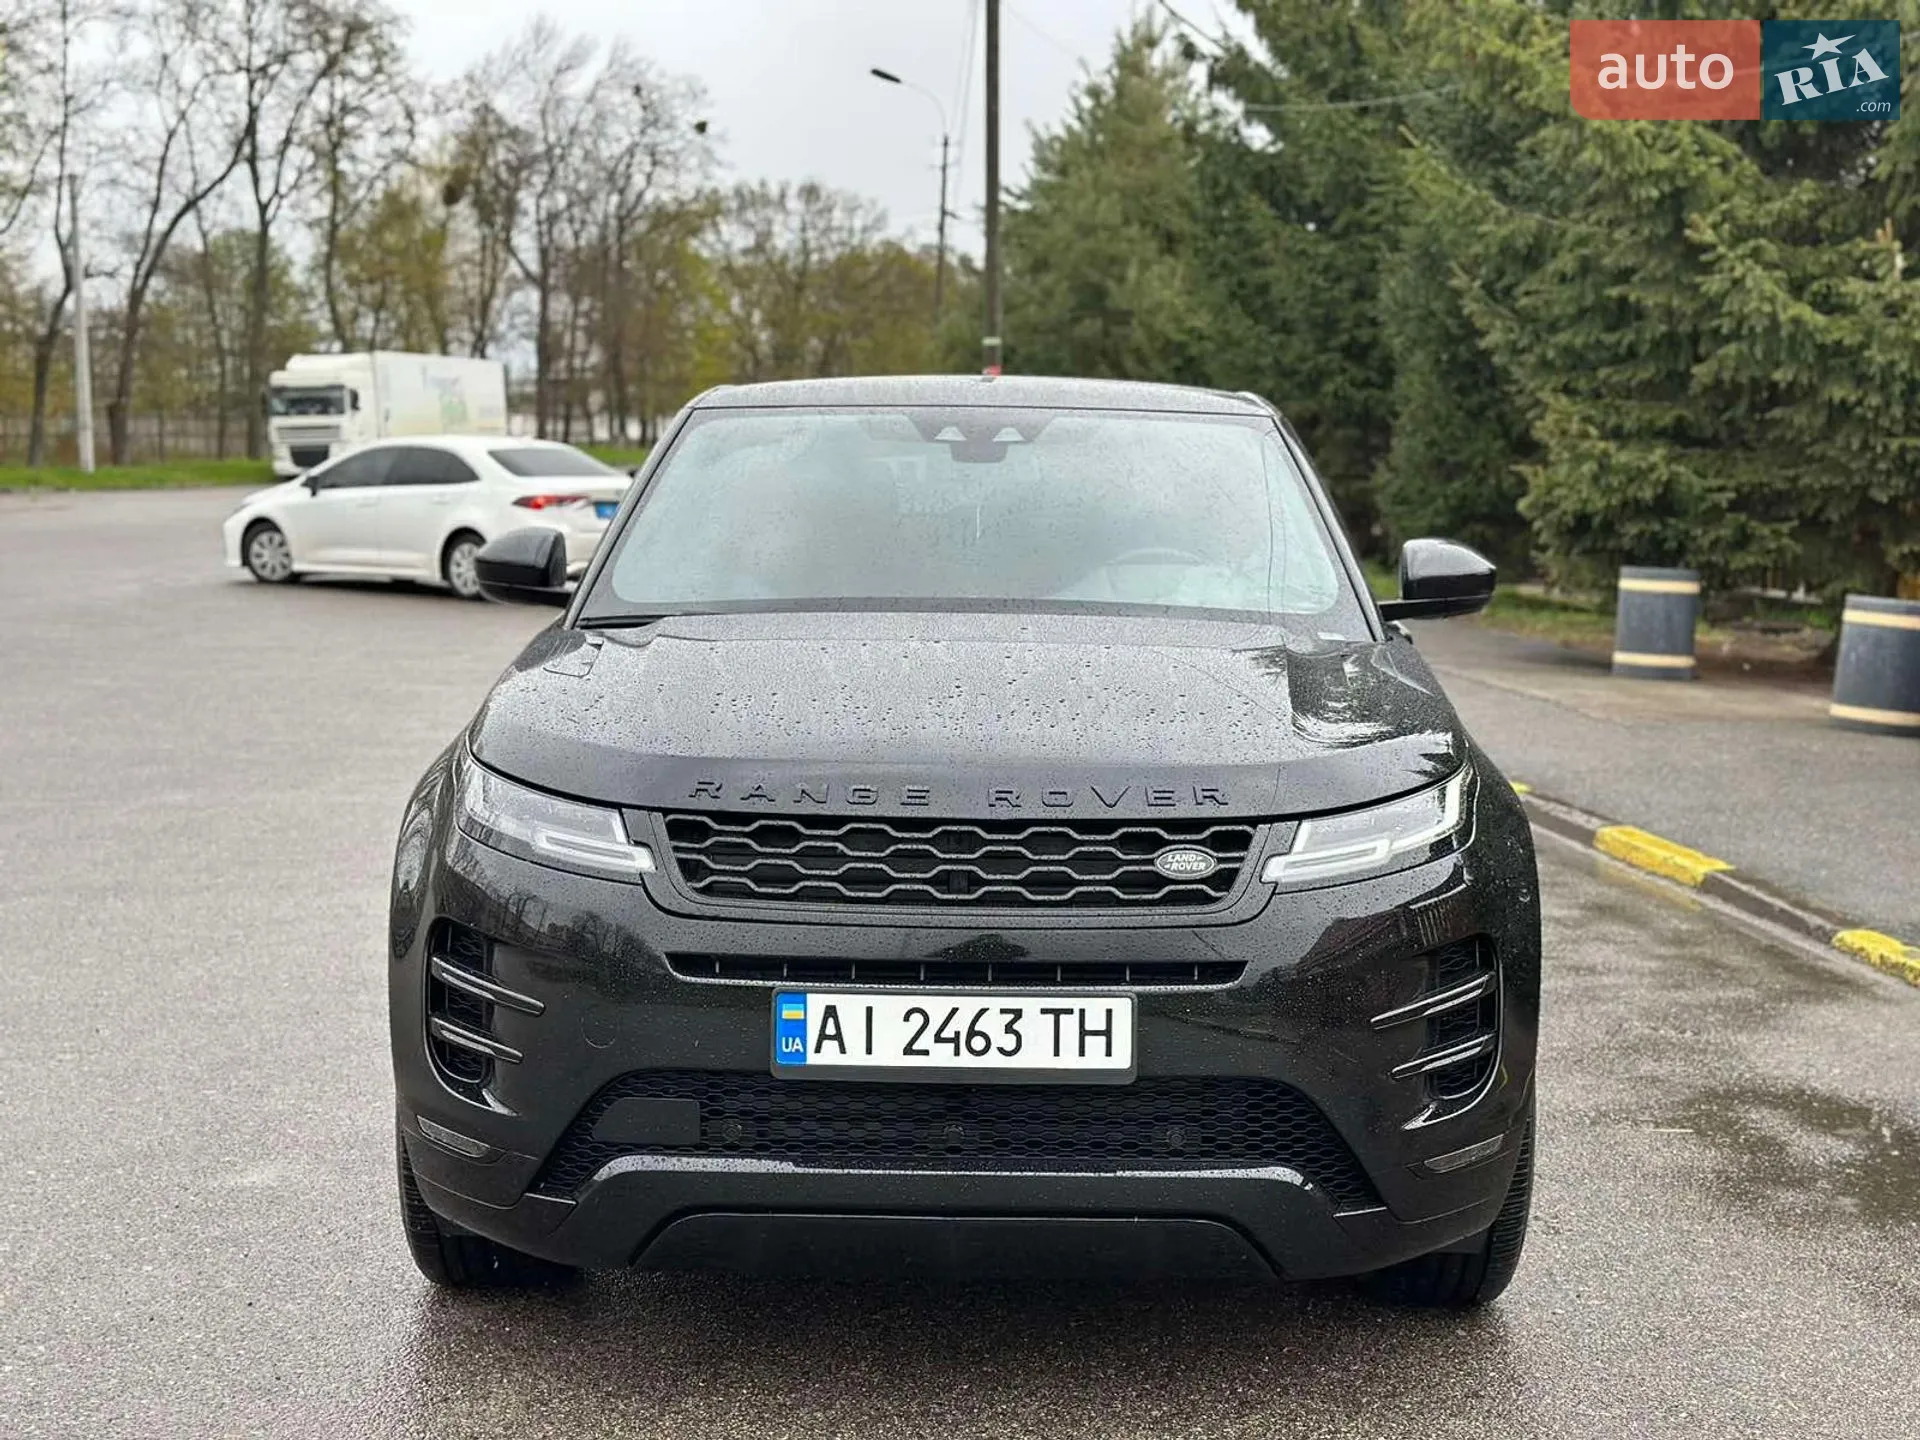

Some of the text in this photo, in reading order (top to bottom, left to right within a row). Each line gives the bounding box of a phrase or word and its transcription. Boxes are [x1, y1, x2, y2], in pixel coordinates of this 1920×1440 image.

[688, 781, 1228, 808] RANGE ROVER
[814, 1004, 1113, 1057] AI 2463 TH
[781, 1036, 804, 1053] UA
